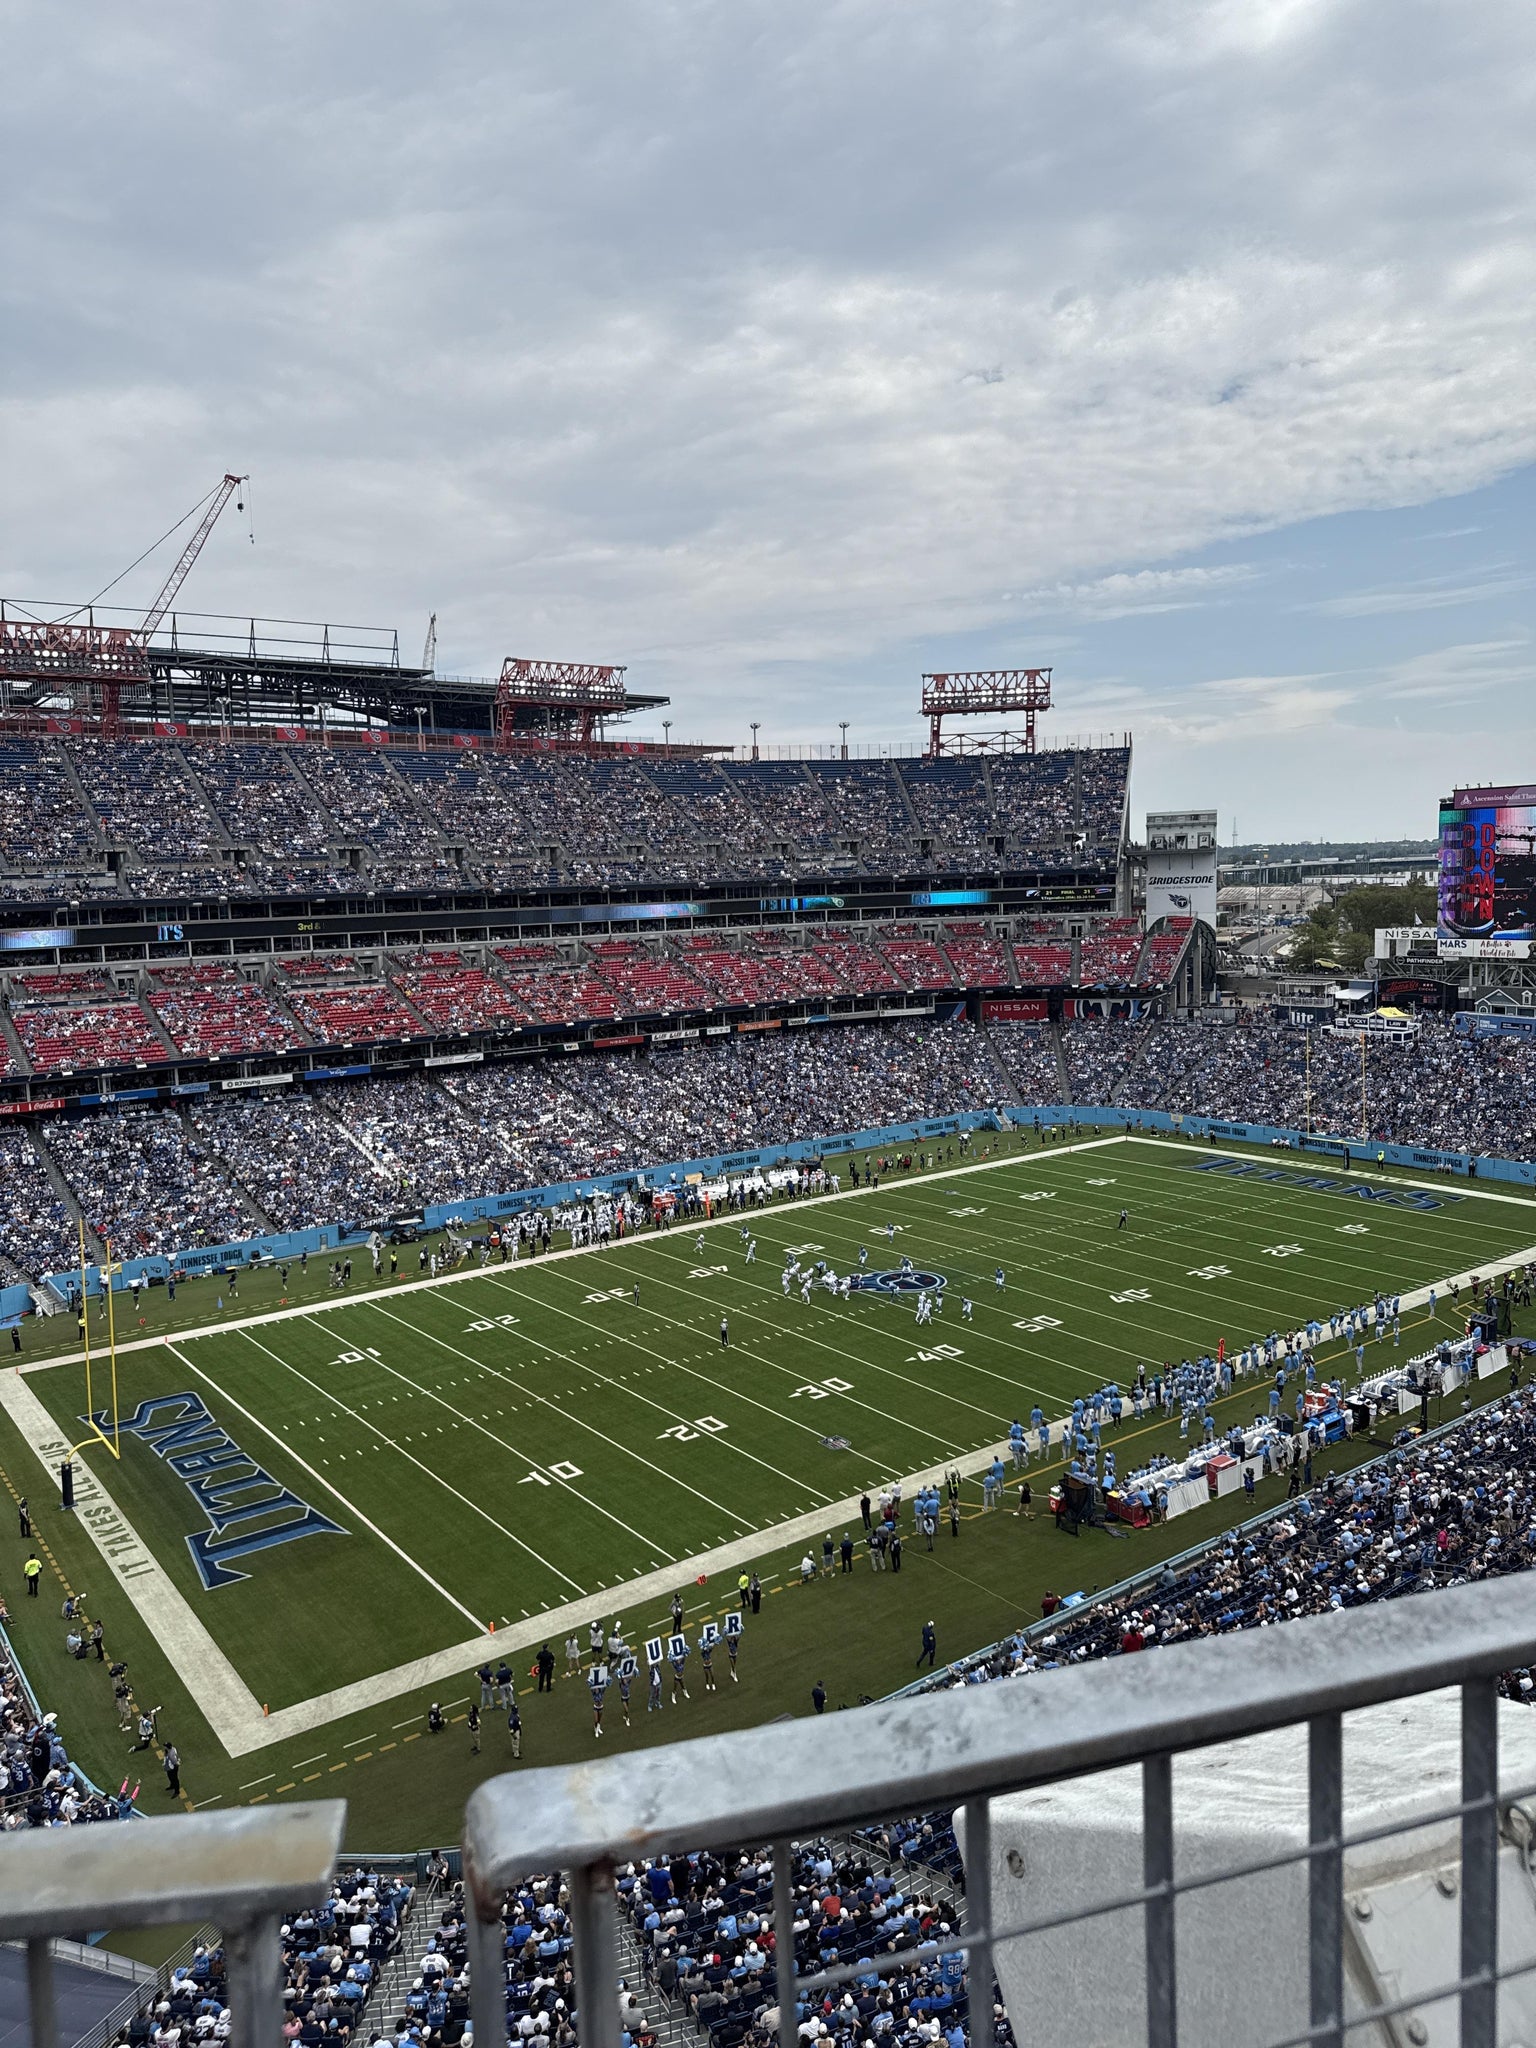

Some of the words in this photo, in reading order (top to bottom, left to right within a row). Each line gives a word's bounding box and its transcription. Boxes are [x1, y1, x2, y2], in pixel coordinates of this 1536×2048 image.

[1148, 875, 1214, 885] BRIDGESTONE
[158, 924, 183, 941] IT'S
[297, 923, 313, 931] 3rd
[1440, 940, 1467, 948] MARS
[990, 1003, 1040, 1012] NISSAN
[204, 1093, 238, 1102] HOUSTON
[118, 1103, 149, 1112] NORTON
[1207, 1124, 1231, 1135] TENNESSEE
[1413, 1152, 1443, 1165] TENNESSEE
[1444, 1157, 1463, 1168] TOUGH
[783, 1243, 825, 1255] 50
[1261, 1243, 1305, 1257] 20
[181, 1253, 219, 1269] TENNESSEE
[220, 1249, 243, 1262] TOUGH
[690, 1264, 729, 1279] 40
[1186, 1265, 1233, 1280] 30
[584, 1287, 634, 1304] 30
[1109, 1288, 1152, 1304] 40
[468, 1314, 521, 1332] 20
[1011, 1314, 1064, 1332] 50
[337, 1347, 383, 1364] 10
[917, 1343, 965, 1362] 40
[795, 1376, 855, 1400] 30
[665, 1415, 729, 1442] 20
[38, 1441, 71, 1459] US
[529, 1460, 585, 1487] 10
[77, 1391, 352, 1591] TITANS
[83, 1505, 139, 1558] TAKES
[117, 1559, 155, 1580] IT
[318, 1910, 330, 1920] 34
[947, 1964, 960, 1976] 98
